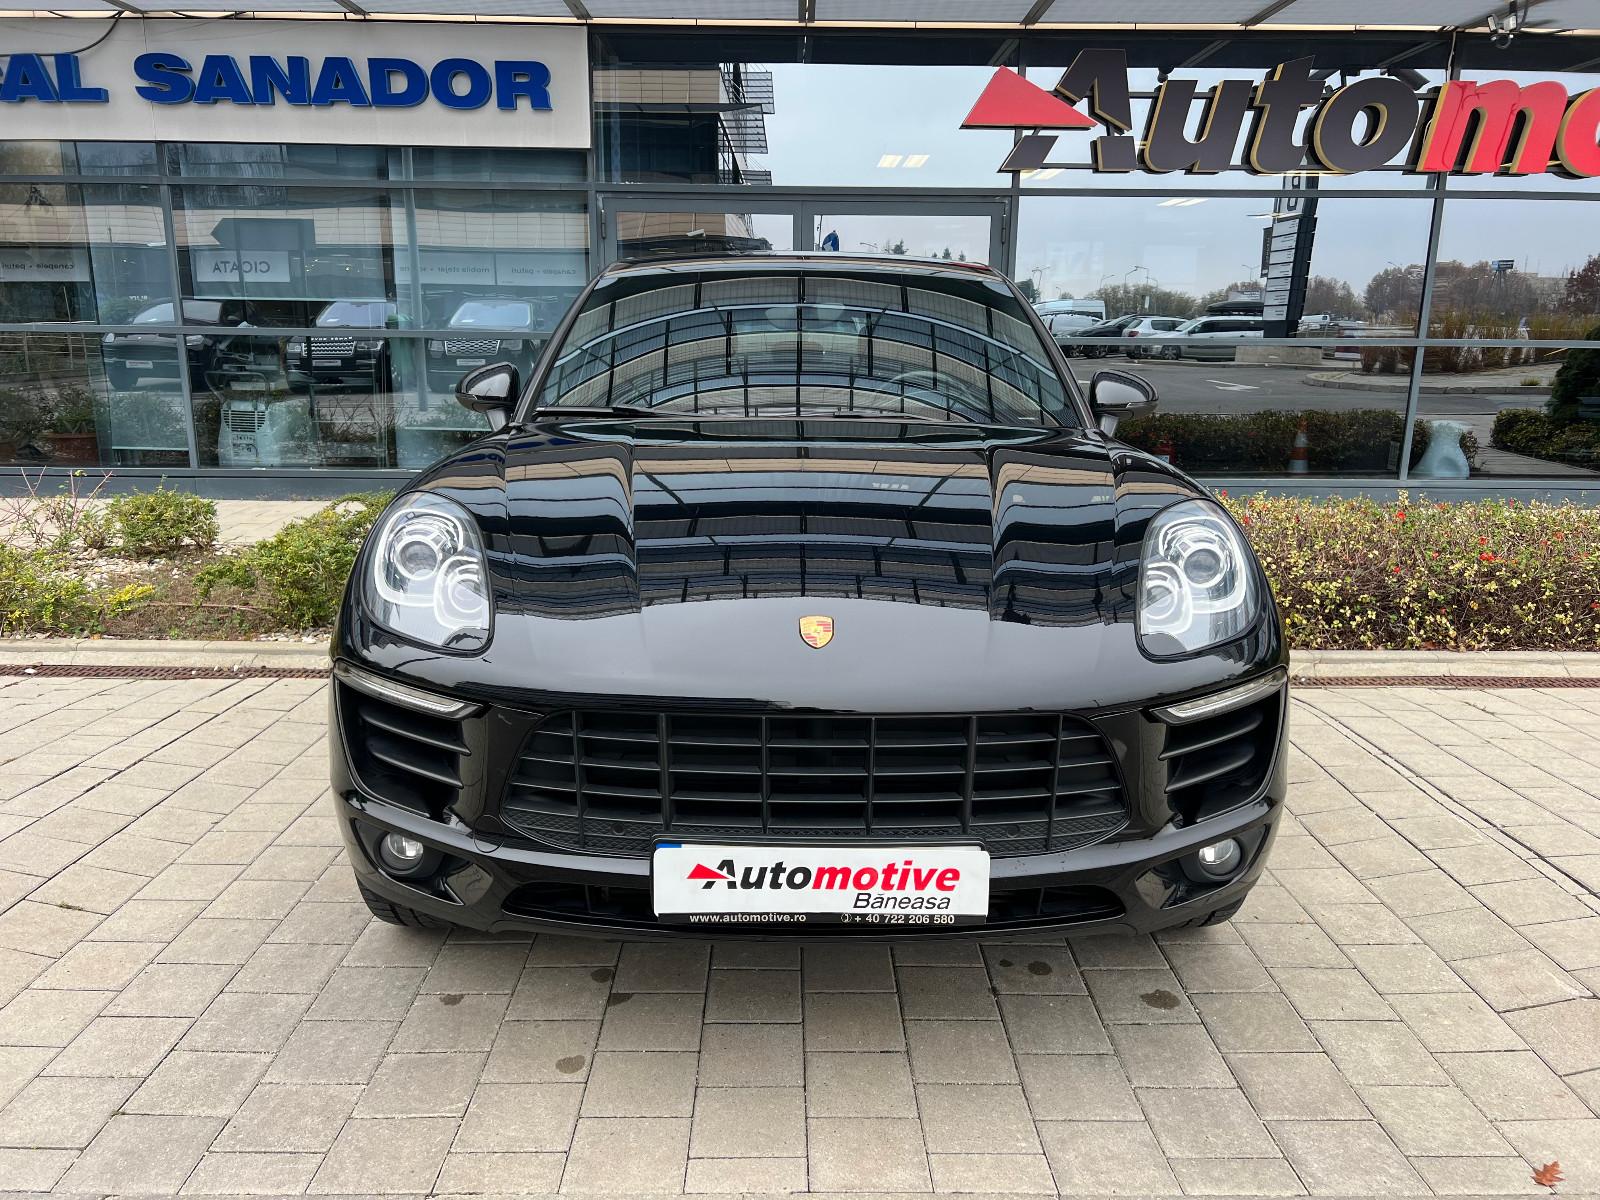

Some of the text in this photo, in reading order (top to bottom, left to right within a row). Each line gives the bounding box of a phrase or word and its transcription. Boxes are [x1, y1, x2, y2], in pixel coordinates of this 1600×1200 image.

[0, 52, 553, 112] AL SANADOR
[686, 859, 961, 892] Automotive
[853, 892, 951, 910] Băneasa
[689, 913, 807, 923] www.automotive.ro
[865, 914, 880, 923] 40
[884, 914, 905, 924] 722
[908, 915, 930, 924] 206
[933, 915, 955, 924] 580
